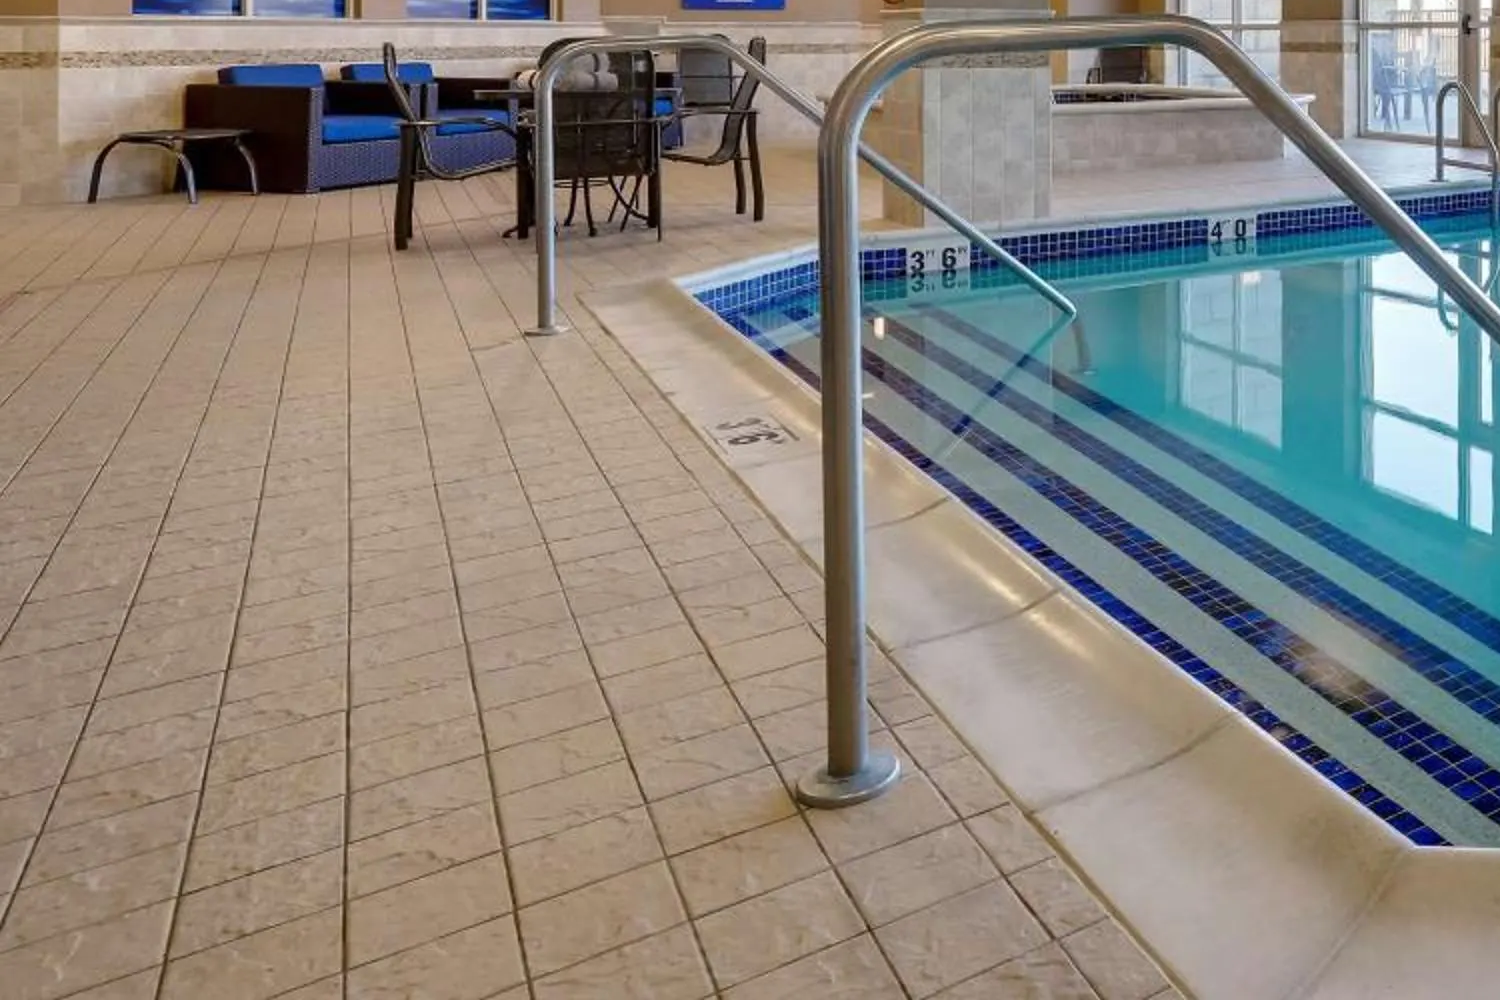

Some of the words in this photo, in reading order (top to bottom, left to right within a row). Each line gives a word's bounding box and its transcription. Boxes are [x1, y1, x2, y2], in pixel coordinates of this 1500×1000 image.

[1210, 221, 1223, 241] 4
[910, 251, 925, 272] 3
[941, 247, 957, 269] 6
